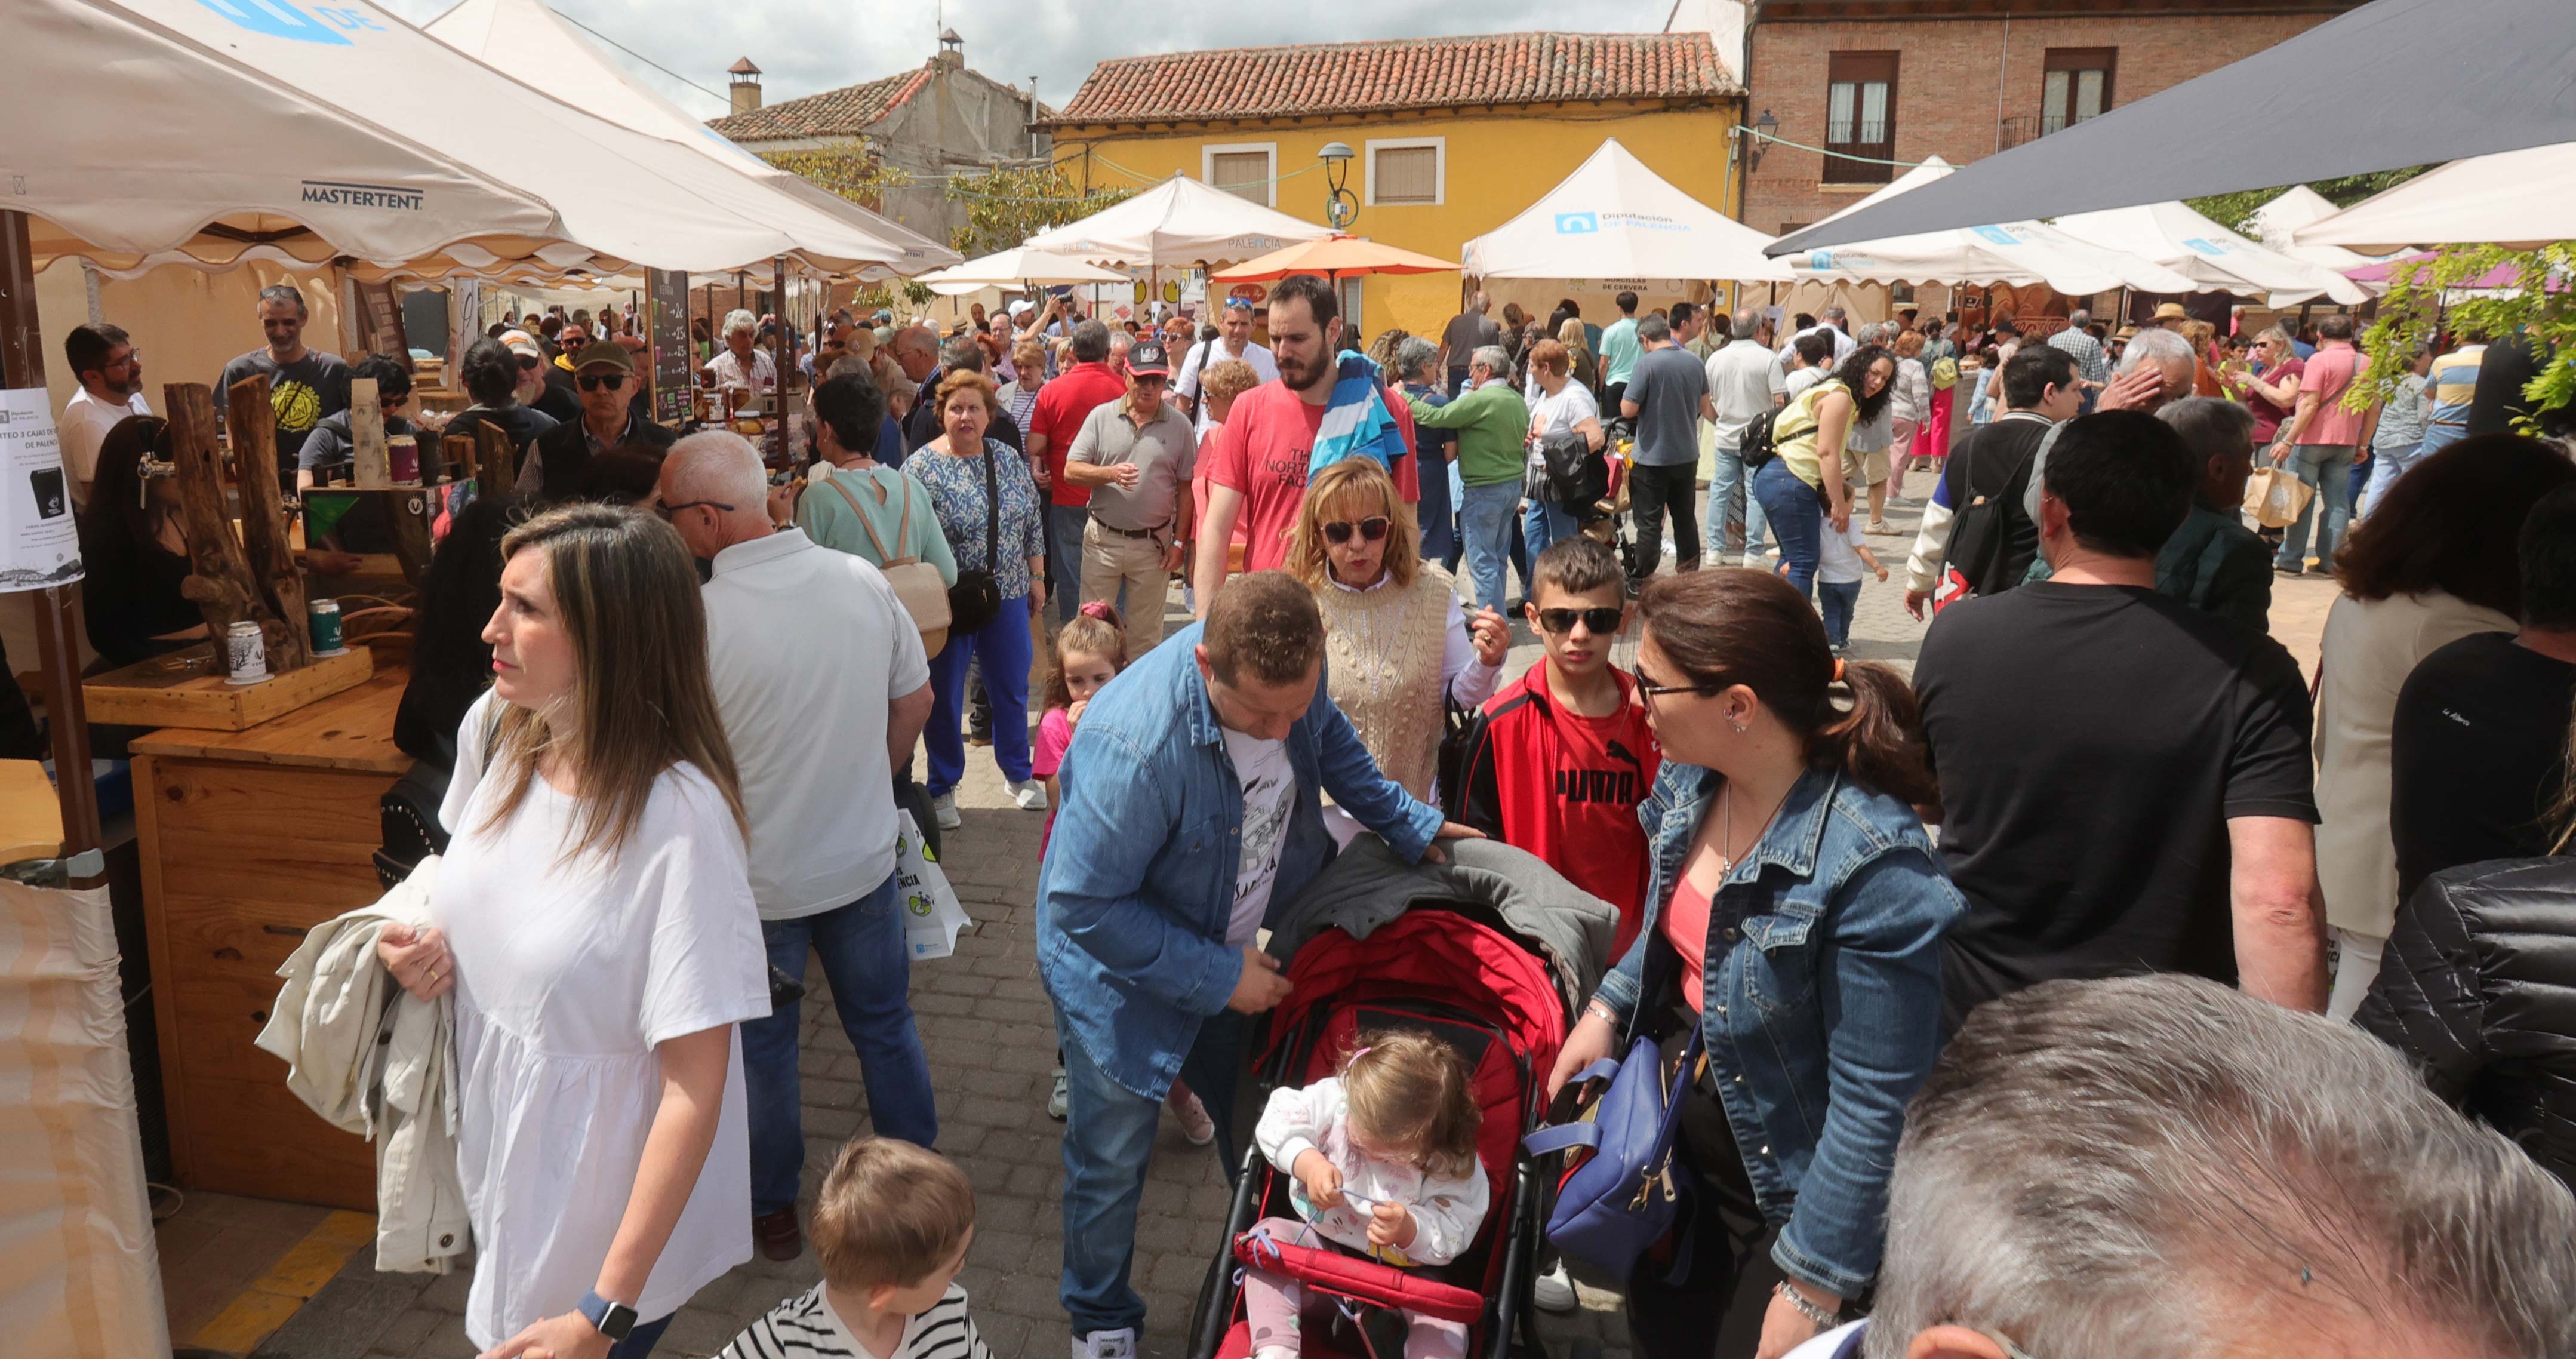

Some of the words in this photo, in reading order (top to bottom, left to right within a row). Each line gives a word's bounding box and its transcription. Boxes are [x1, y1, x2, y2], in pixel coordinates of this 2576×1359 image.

[313, 7, 389, 31] DE
[302, 187, 423, 210] MASTERTENT
[1602, 213, 1672, 223] Diputación
[1626, 220, 1691, 232] PALENCIA
[1228, 238, 1281, 249] PALENCIA
